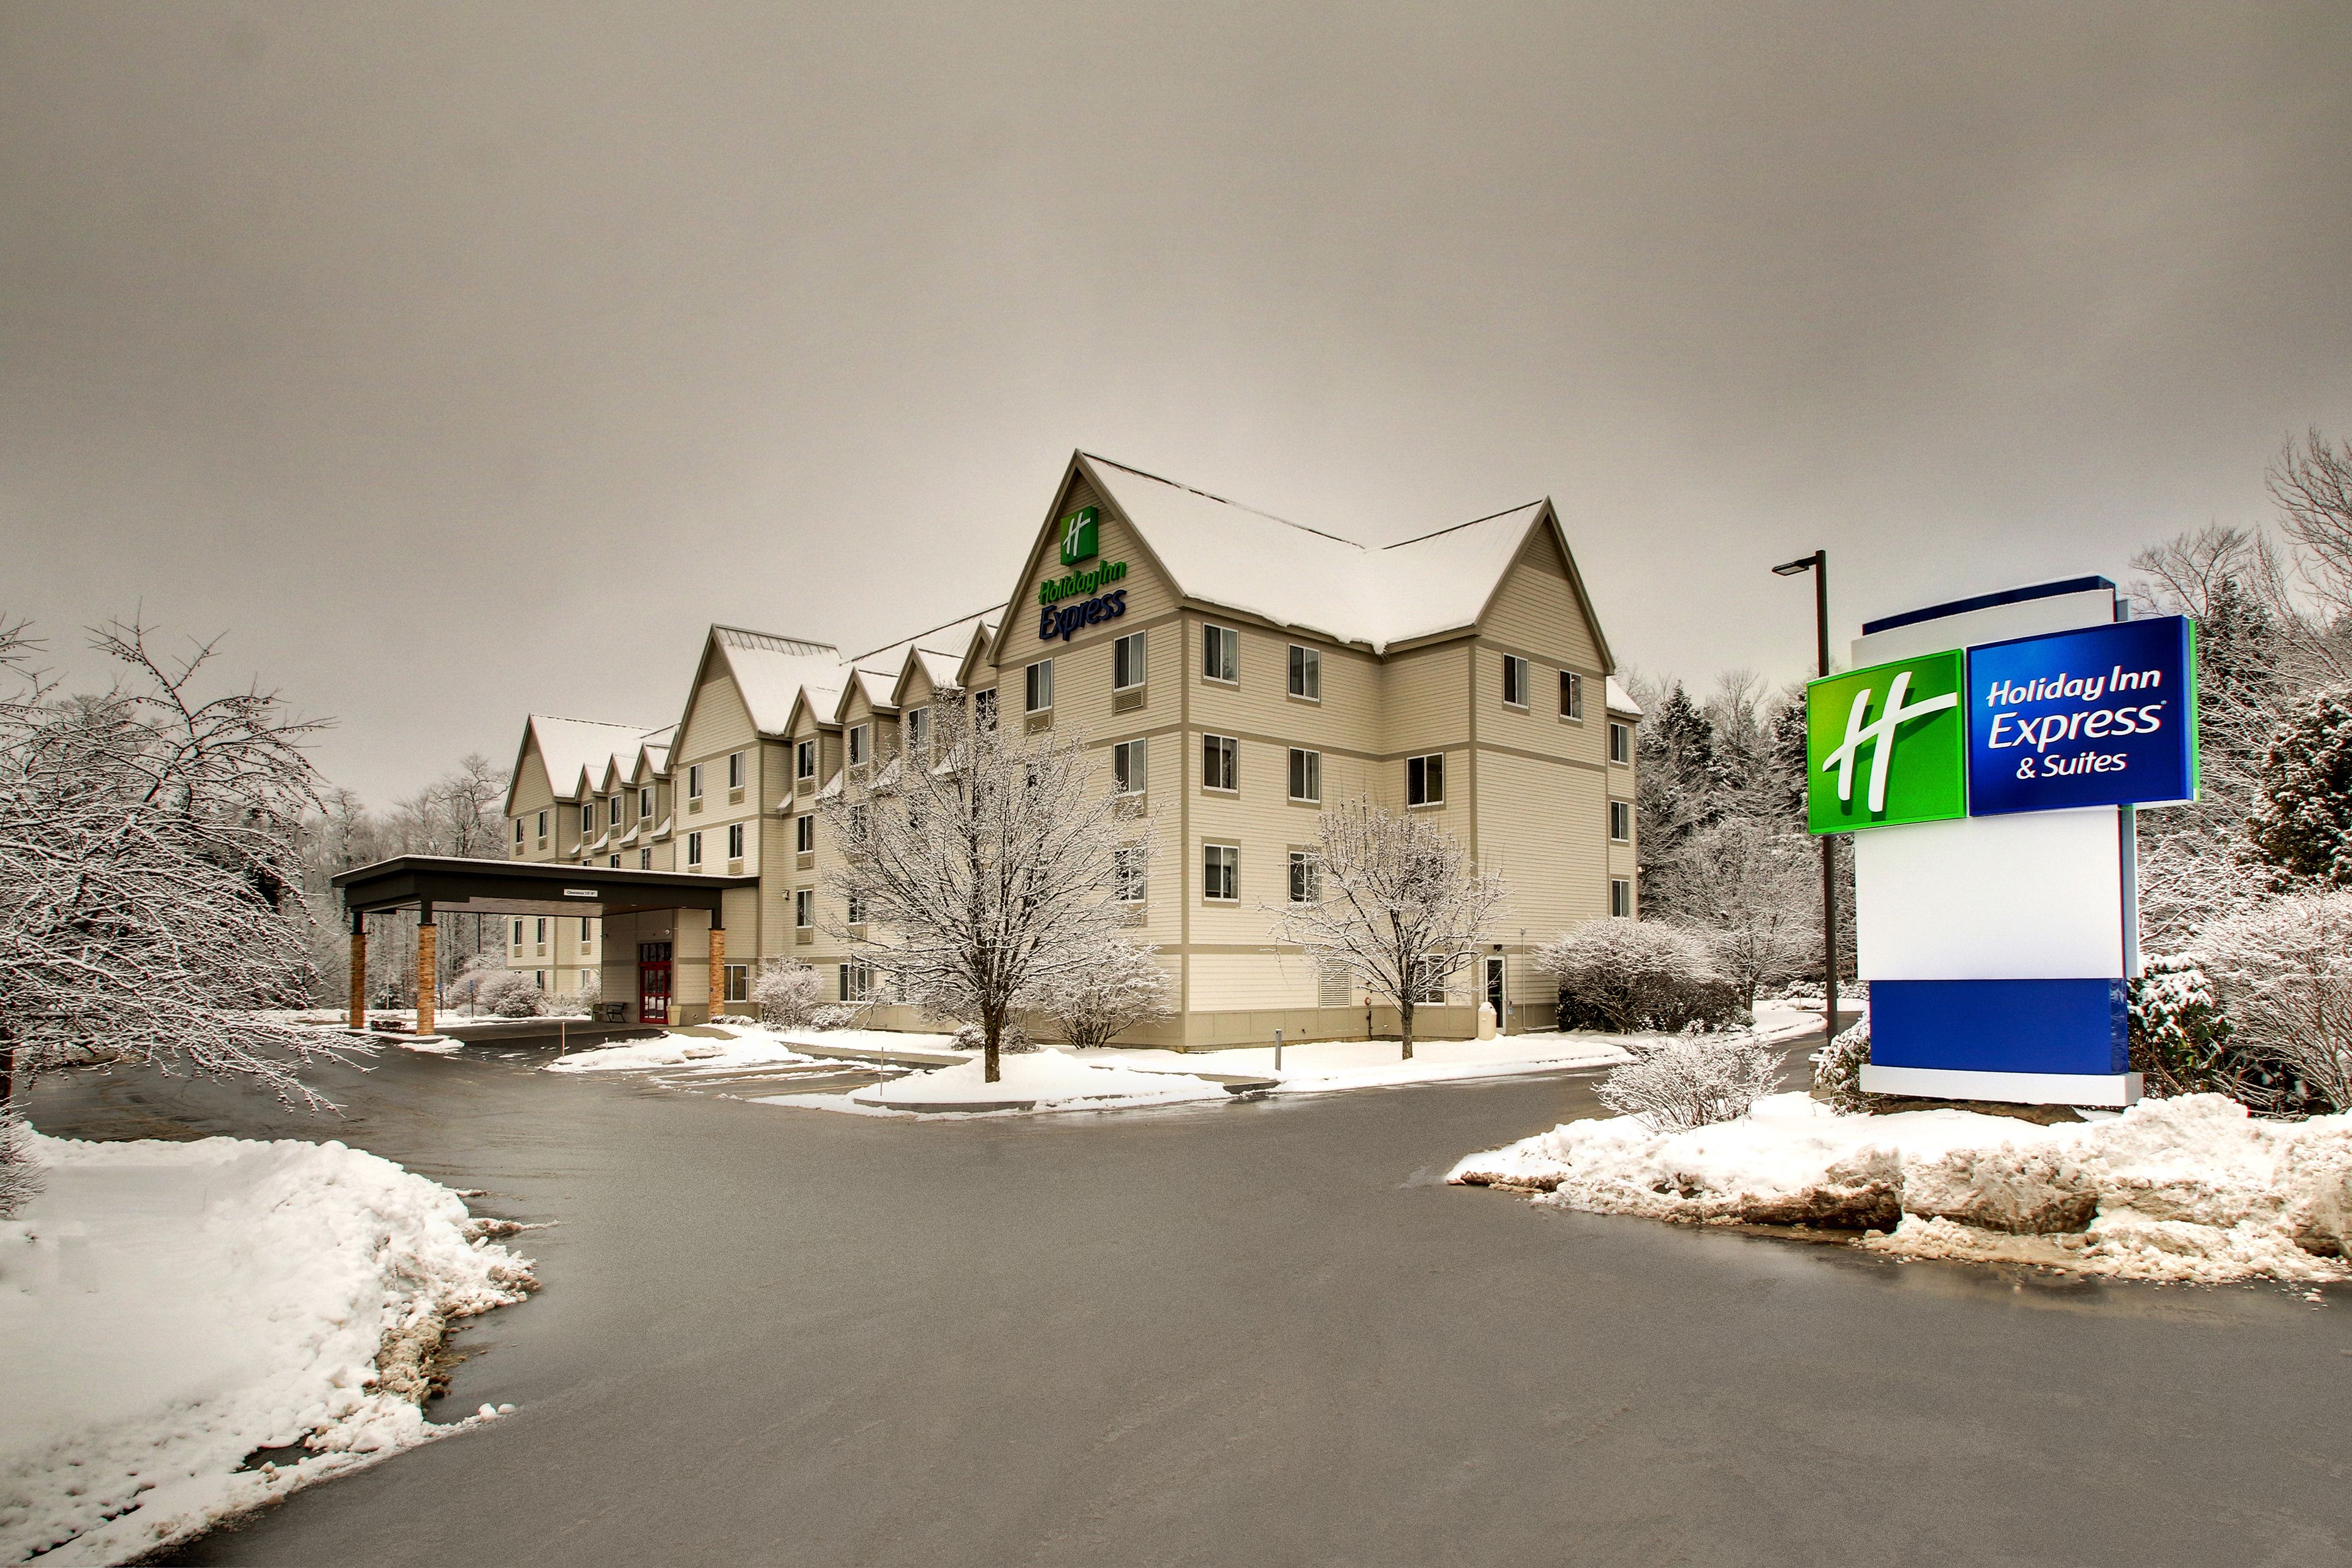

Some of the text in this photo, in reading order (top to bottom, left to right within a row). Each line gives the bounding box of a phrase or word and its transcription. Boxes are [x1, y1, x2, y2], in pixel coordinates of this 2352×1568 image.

[1039, 560, 1126, 605] Holiday Inn
[1039, 589, 1127, 641] Express
[1986, 665, 2162, 707] Holiday Inn
[1988, 704, 2162, 753] Express
[2016, 752, 2127, 780] & Suites
